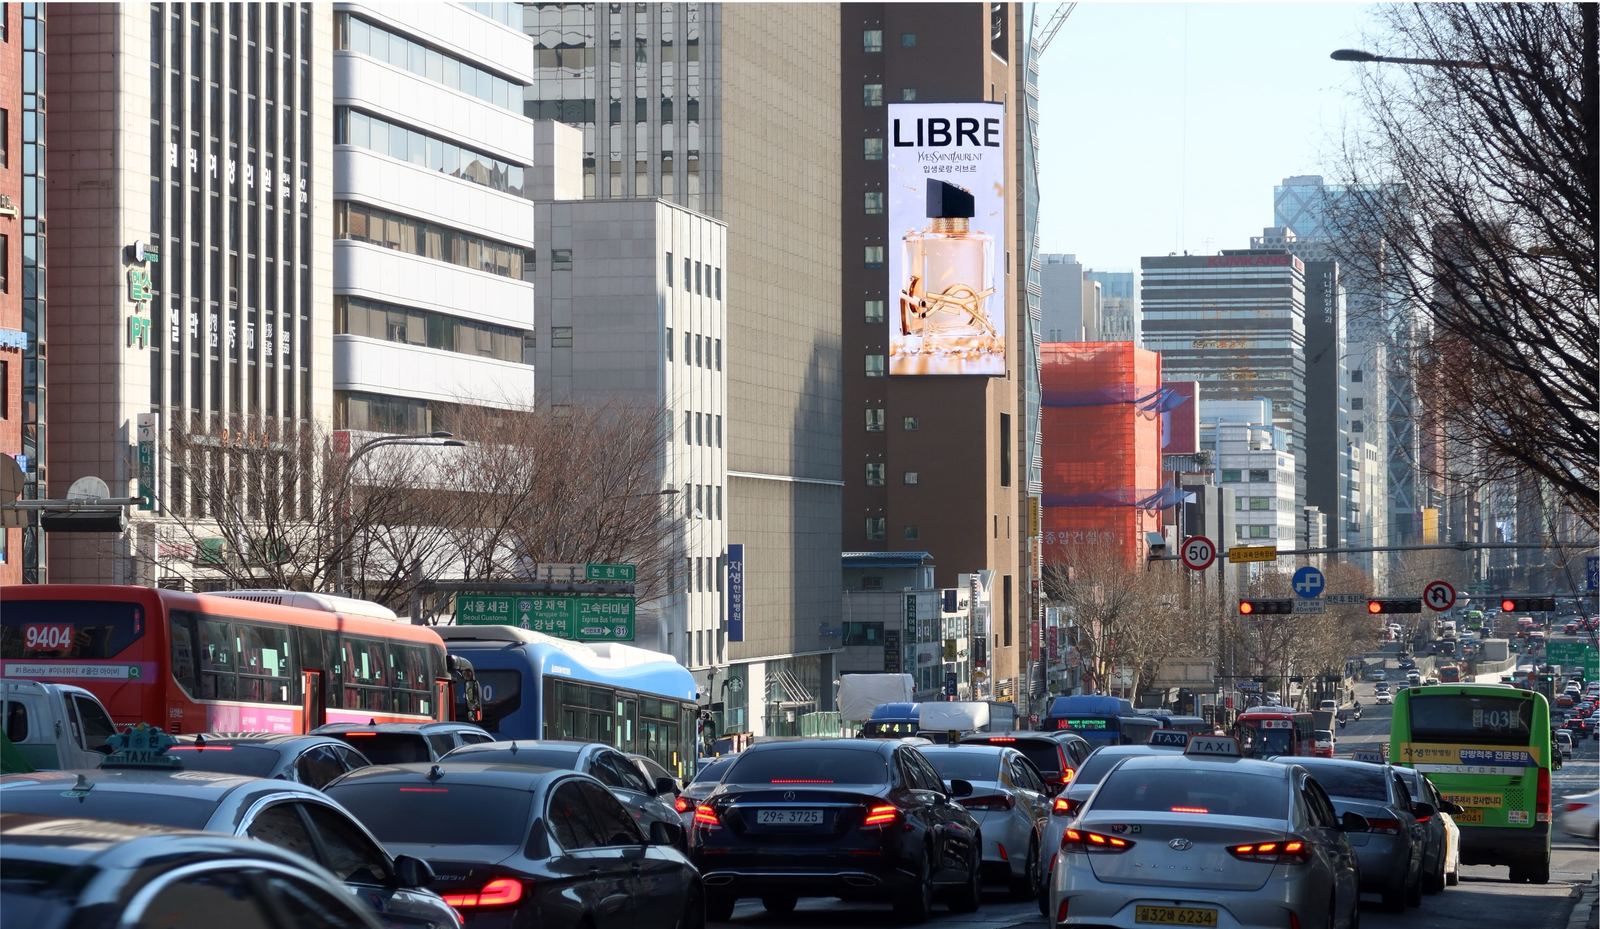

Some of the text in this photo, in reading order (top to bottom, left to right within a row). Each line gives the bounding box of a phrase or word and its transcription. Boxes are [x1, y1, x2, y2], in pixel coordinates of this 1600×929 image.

[893, 117, 1000, 148] LIBRE
[917, 151, 983, 163] YVES SAINT LAURENT
[923, 165, 977, 173] 입생로랑 리브르
[131, 270, 152, 346] 헬스 PT
[1189, 546, 1209, 561] 50
[591, 567, 629, 578] 논현역
[729, 561, 743, 621] 자생한방병원
[463, 601, 509, 613] 서울세관
[520, 602, 530, 610] 92
[533, 600, 567, 611] 양재역
[580, 603, 629, 615] 고속터미널
[534, 619, 567, 630] 강남역
[582, 616, 627, 624] Express Bus Terminal
[616, 627, 626, 635] 31
[26, 626, 71, 649] 9404
[23, 666, 46, 675] Beauty
[1490, 710, 1509, 728] 03
[1157, 734, 1186, 743] TAXI
[1196, 741, 1231, 752] TAXI
[126, 751, 151, 763] TAXI
[1357, 753, 1380, 761] TAXI
[1460, 749, 1528, 760] 한방척추 전문병원
[1473, 795, 1501, 805] 감사합니다
[762, 810, 819, 823] 29수 3725
[1180, 910, 1212, 924] 6234
